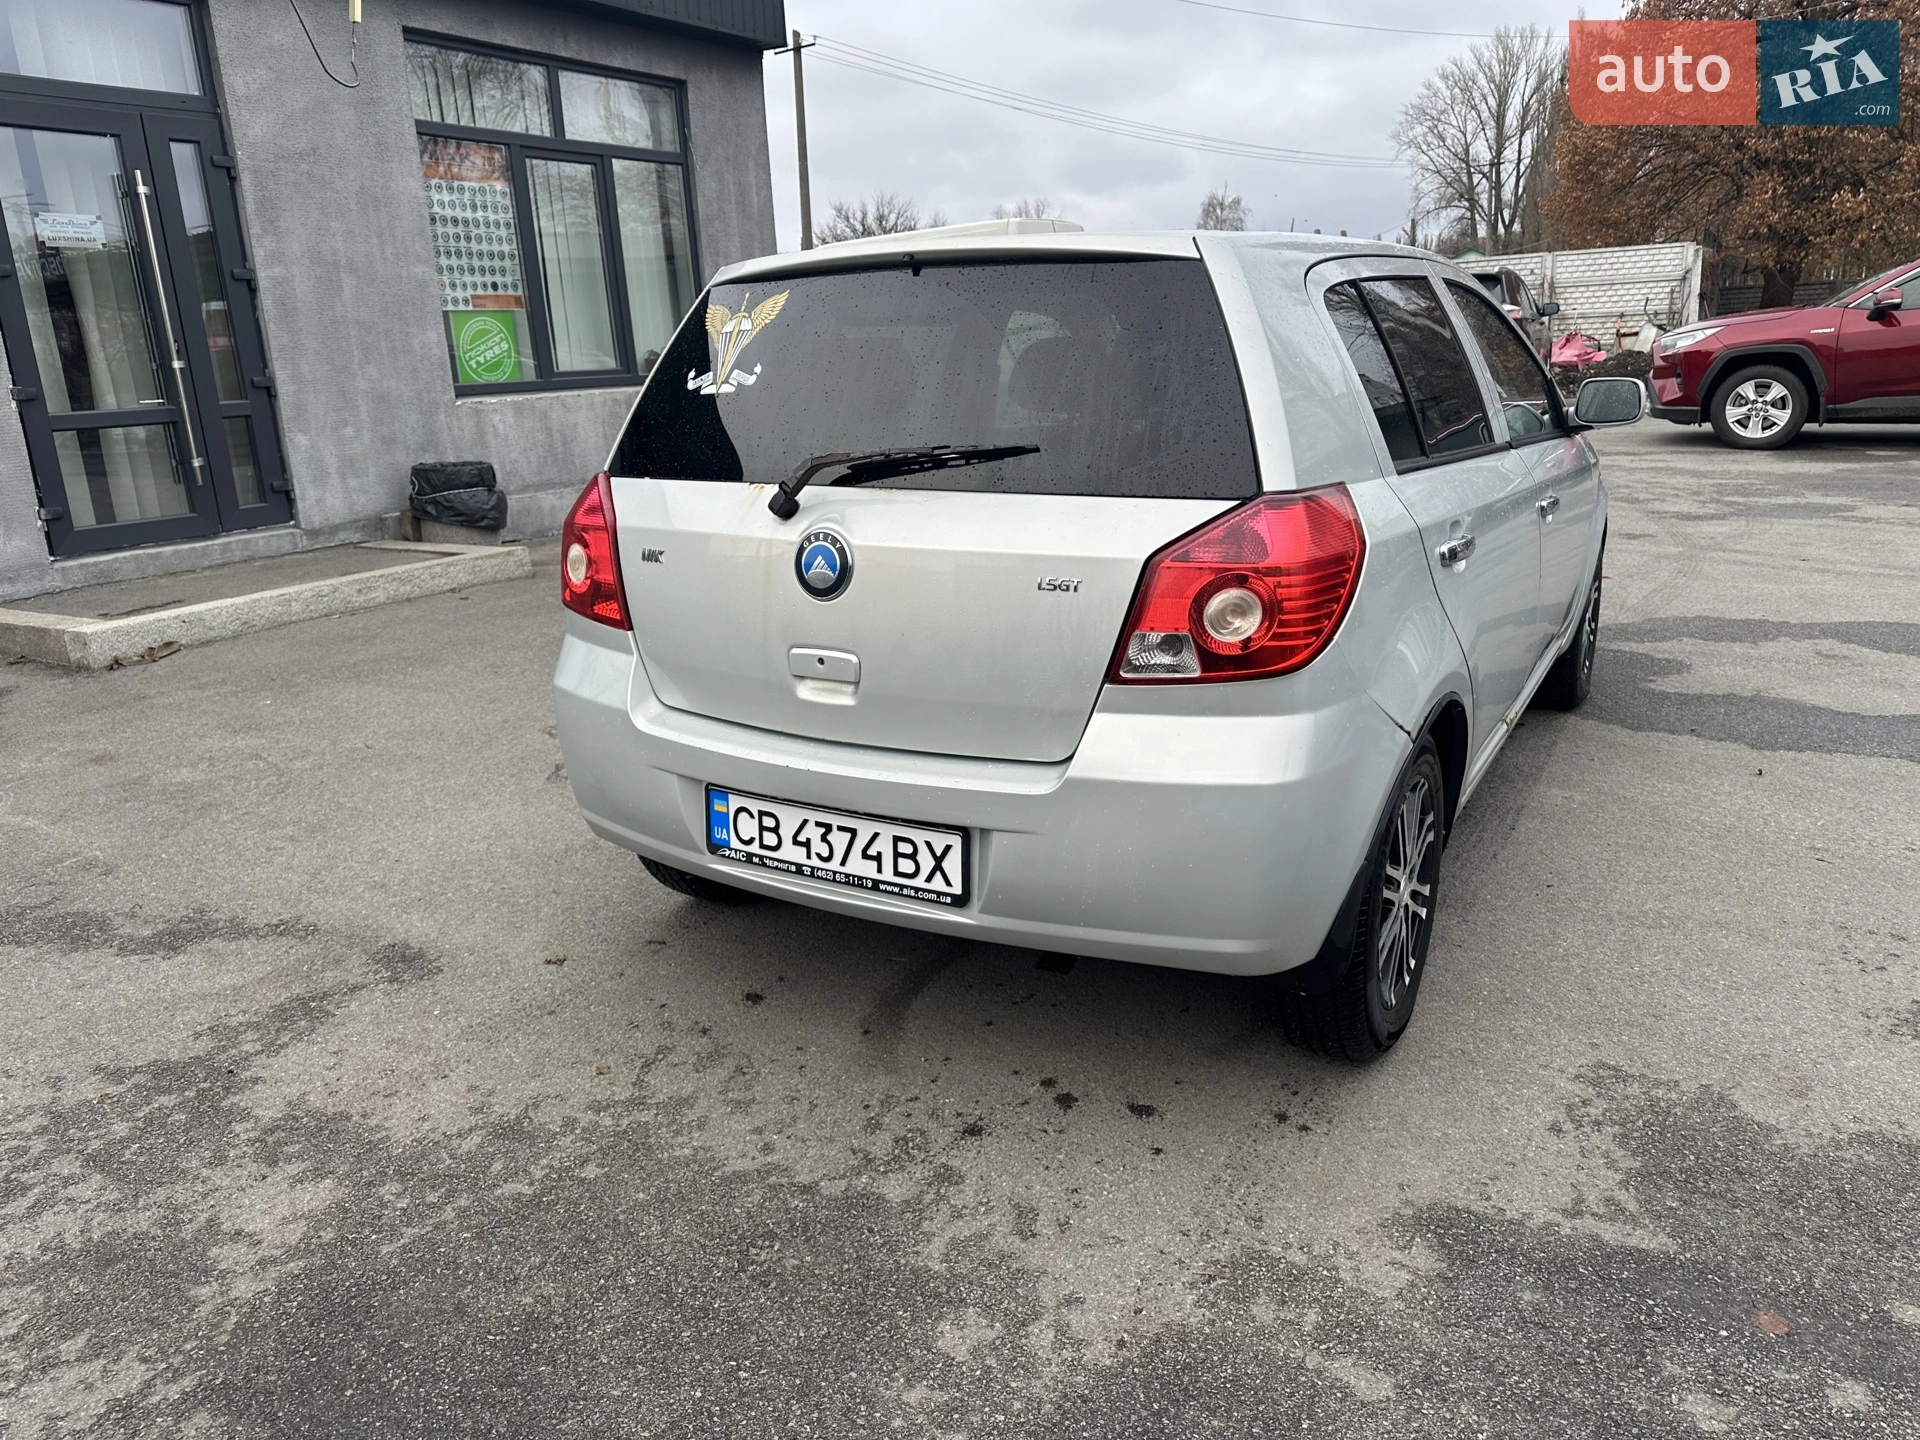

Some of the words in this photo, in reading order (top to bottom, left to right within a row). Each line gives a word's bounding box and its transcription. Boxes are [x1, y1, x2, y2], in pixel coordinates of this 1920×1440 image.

[47, 235, 98, 243] LUXSHINA.UA
[468, 341, 509, 369] TYRES
[803, 533, 842, 549] GEELY
[714, 825, 729, 841] UA
[814, 868, 833, 881] (462)
[835, 872, 873, 888] 65-11-19
[879, 882, 951, 904] www.ais.com.ua
